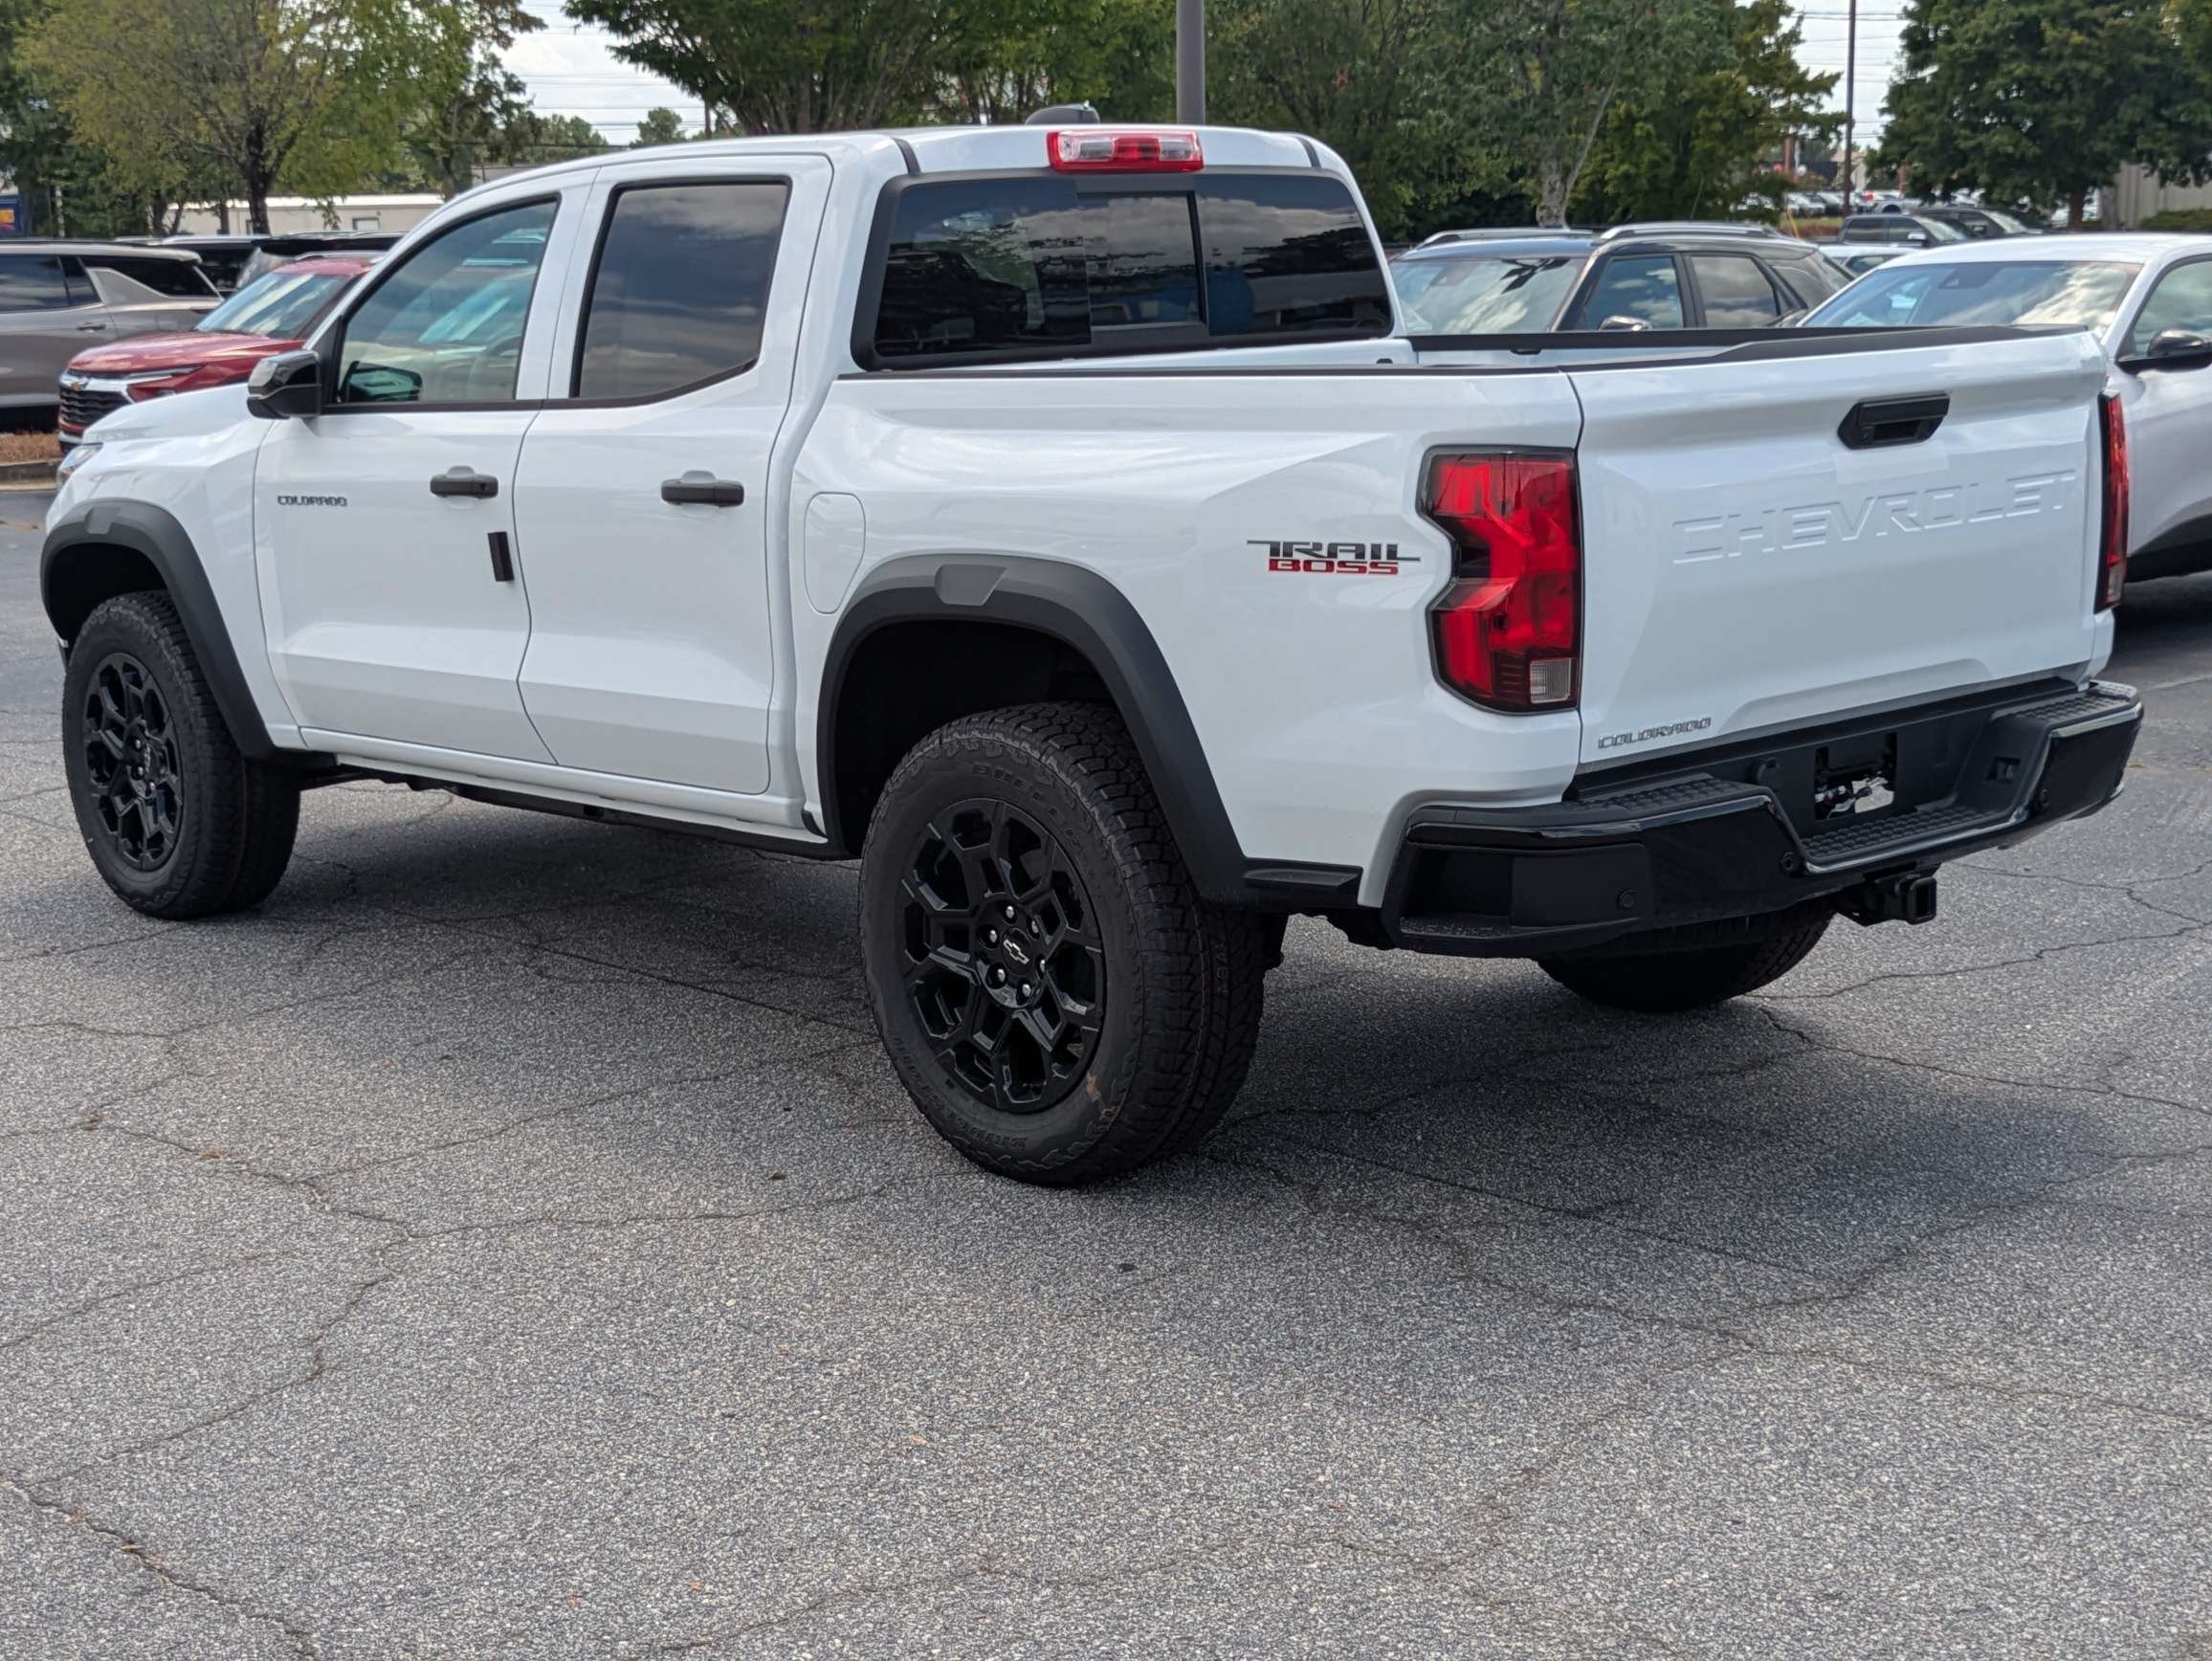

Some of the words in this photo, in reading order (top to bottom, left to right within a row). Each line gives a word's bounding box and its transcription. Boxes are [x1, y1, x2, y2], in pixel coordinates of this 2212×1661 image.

[1672, 469, 2077, 564] CHEVROLET
[1247, 540, 1421, 562] TRAIL
[1269, 558, 1399, 575] BOSS
[1598, 717, 1712, 749] COLORADO
